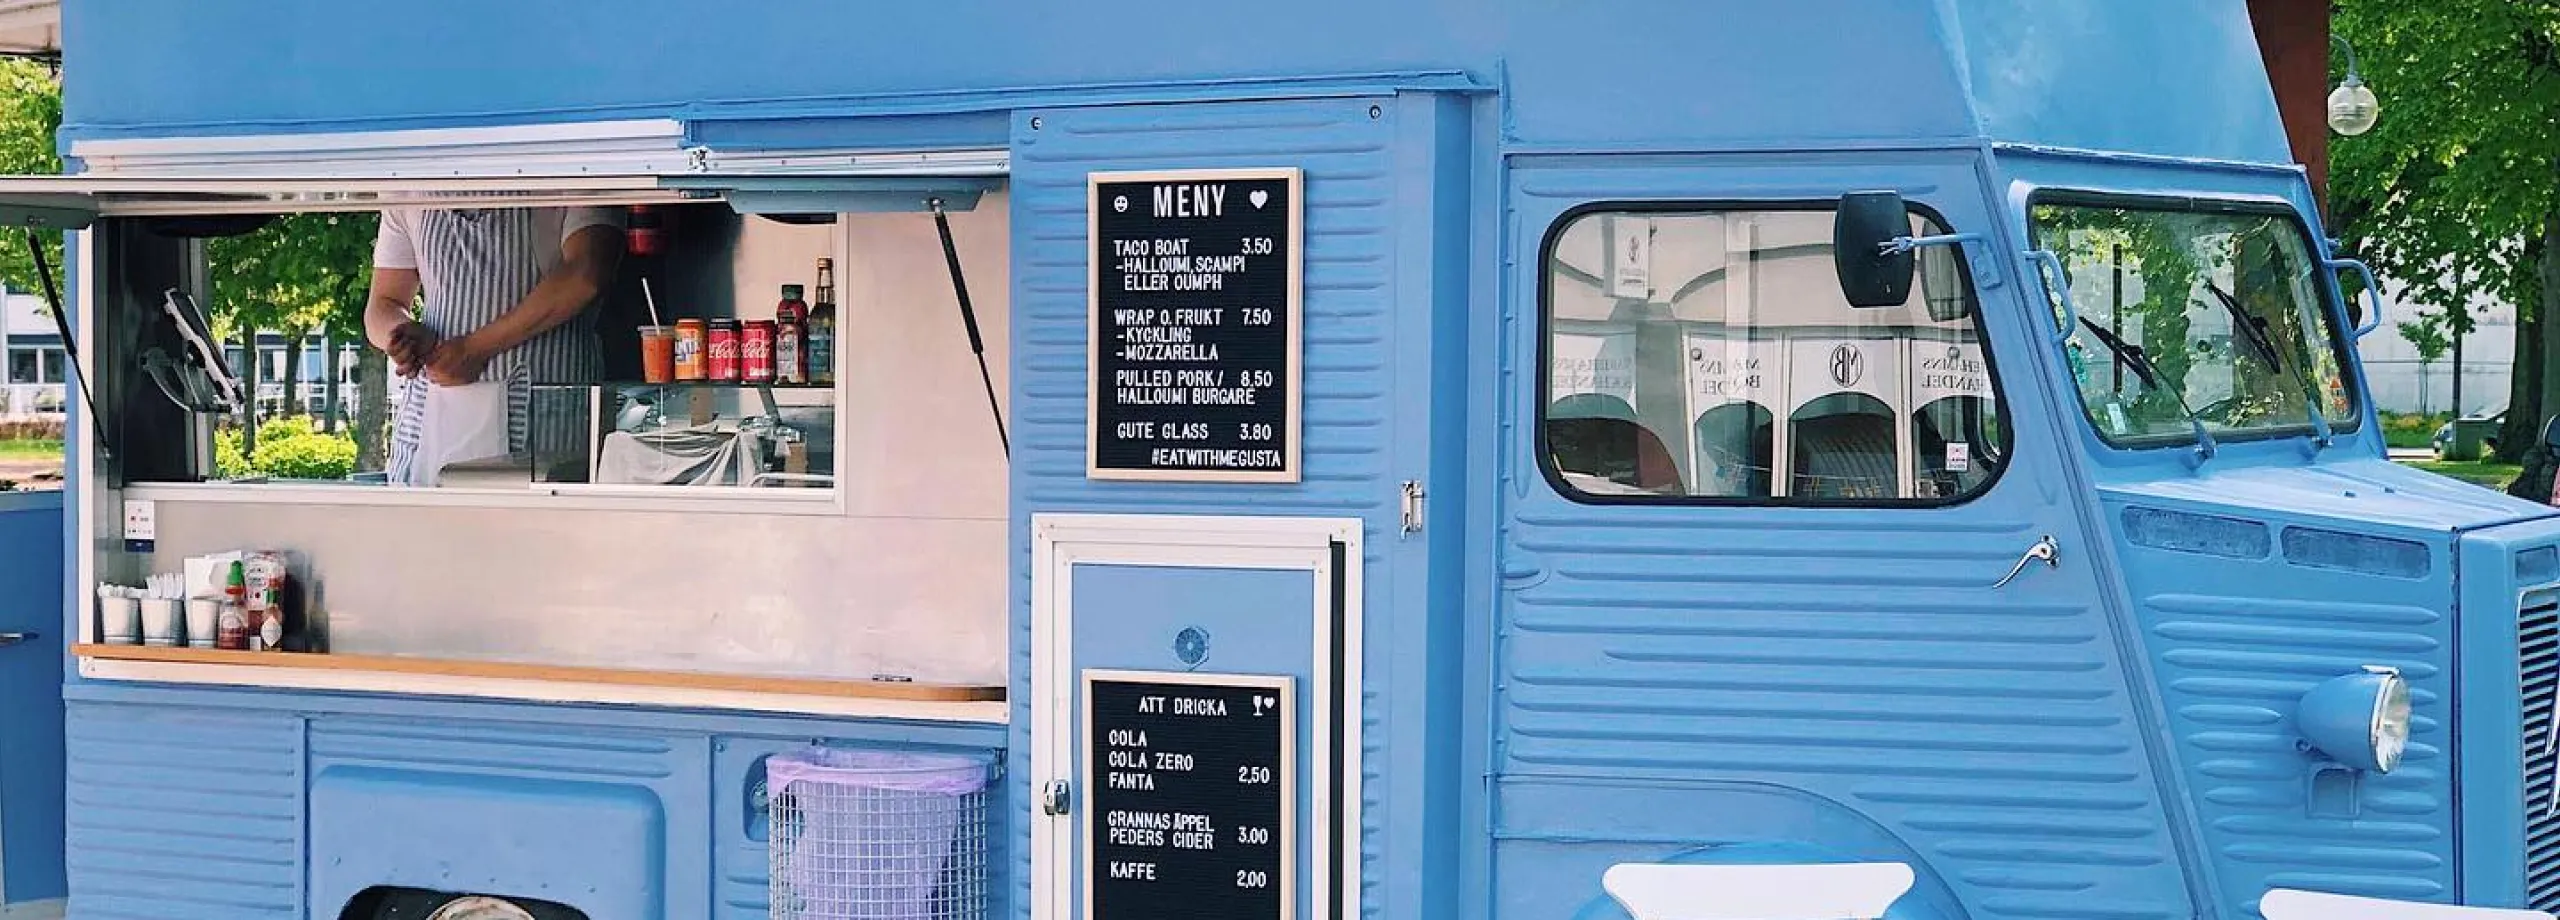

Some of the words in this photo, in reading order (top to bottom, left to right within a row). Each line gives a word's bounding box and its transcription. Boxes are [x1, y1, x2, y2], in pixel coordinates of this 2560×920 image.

[1153, 184, 1226, 217] MENY
[1114, 240, 1149, 256] TACO
[1156, 239, 1189, 255] BOAT
[1242, 238, 1272, 255] 3.50
[1125, 274, 1168, 291] ELLER
[1175, 274, 1222, 291] OUMPH
[1115, 310, 1154, 325] WRAP
[1175, 309, 1223, 325] FRUKT
[1242, 308, 1271, 325] 7.50
[1116, 344, 1219, 361] -MOZZARELLA
[1116, 370, 1172, 387] PULLED
[1241, 370, 1272, 388] 8.50
[1118, 388, 1186, 405] HALLOUMI
[1193, 388, 1256, 405] BURGARE
[1118, 423, 1154, 438] GUTE
[1162, 423, 1209, 438] GLASS
[1240, 423, 1271, 440] 3.80
[1152, 448, 1281, 467] #EATWITHMEGUSTA
[1139, 697, 1165, 714] ATT
[1175, 698, 1227, 716] DRICKA
[1109, 729, 1147, 747] COLA
[1109, 751, 1147, 768] COLA
[1156, 752, 1194, 771] ZERO
[1109, 772, 1154, 790] FANTA
[1108, 811, 1171, 829] GRANNAS
[1110, 829, 1164, 846] PEDERS
[1173, 832, 1213, 849] CIDER
[1239, 827, 1268, 844] 3.00
[1111, 861, 1156, 880] KAFFE
